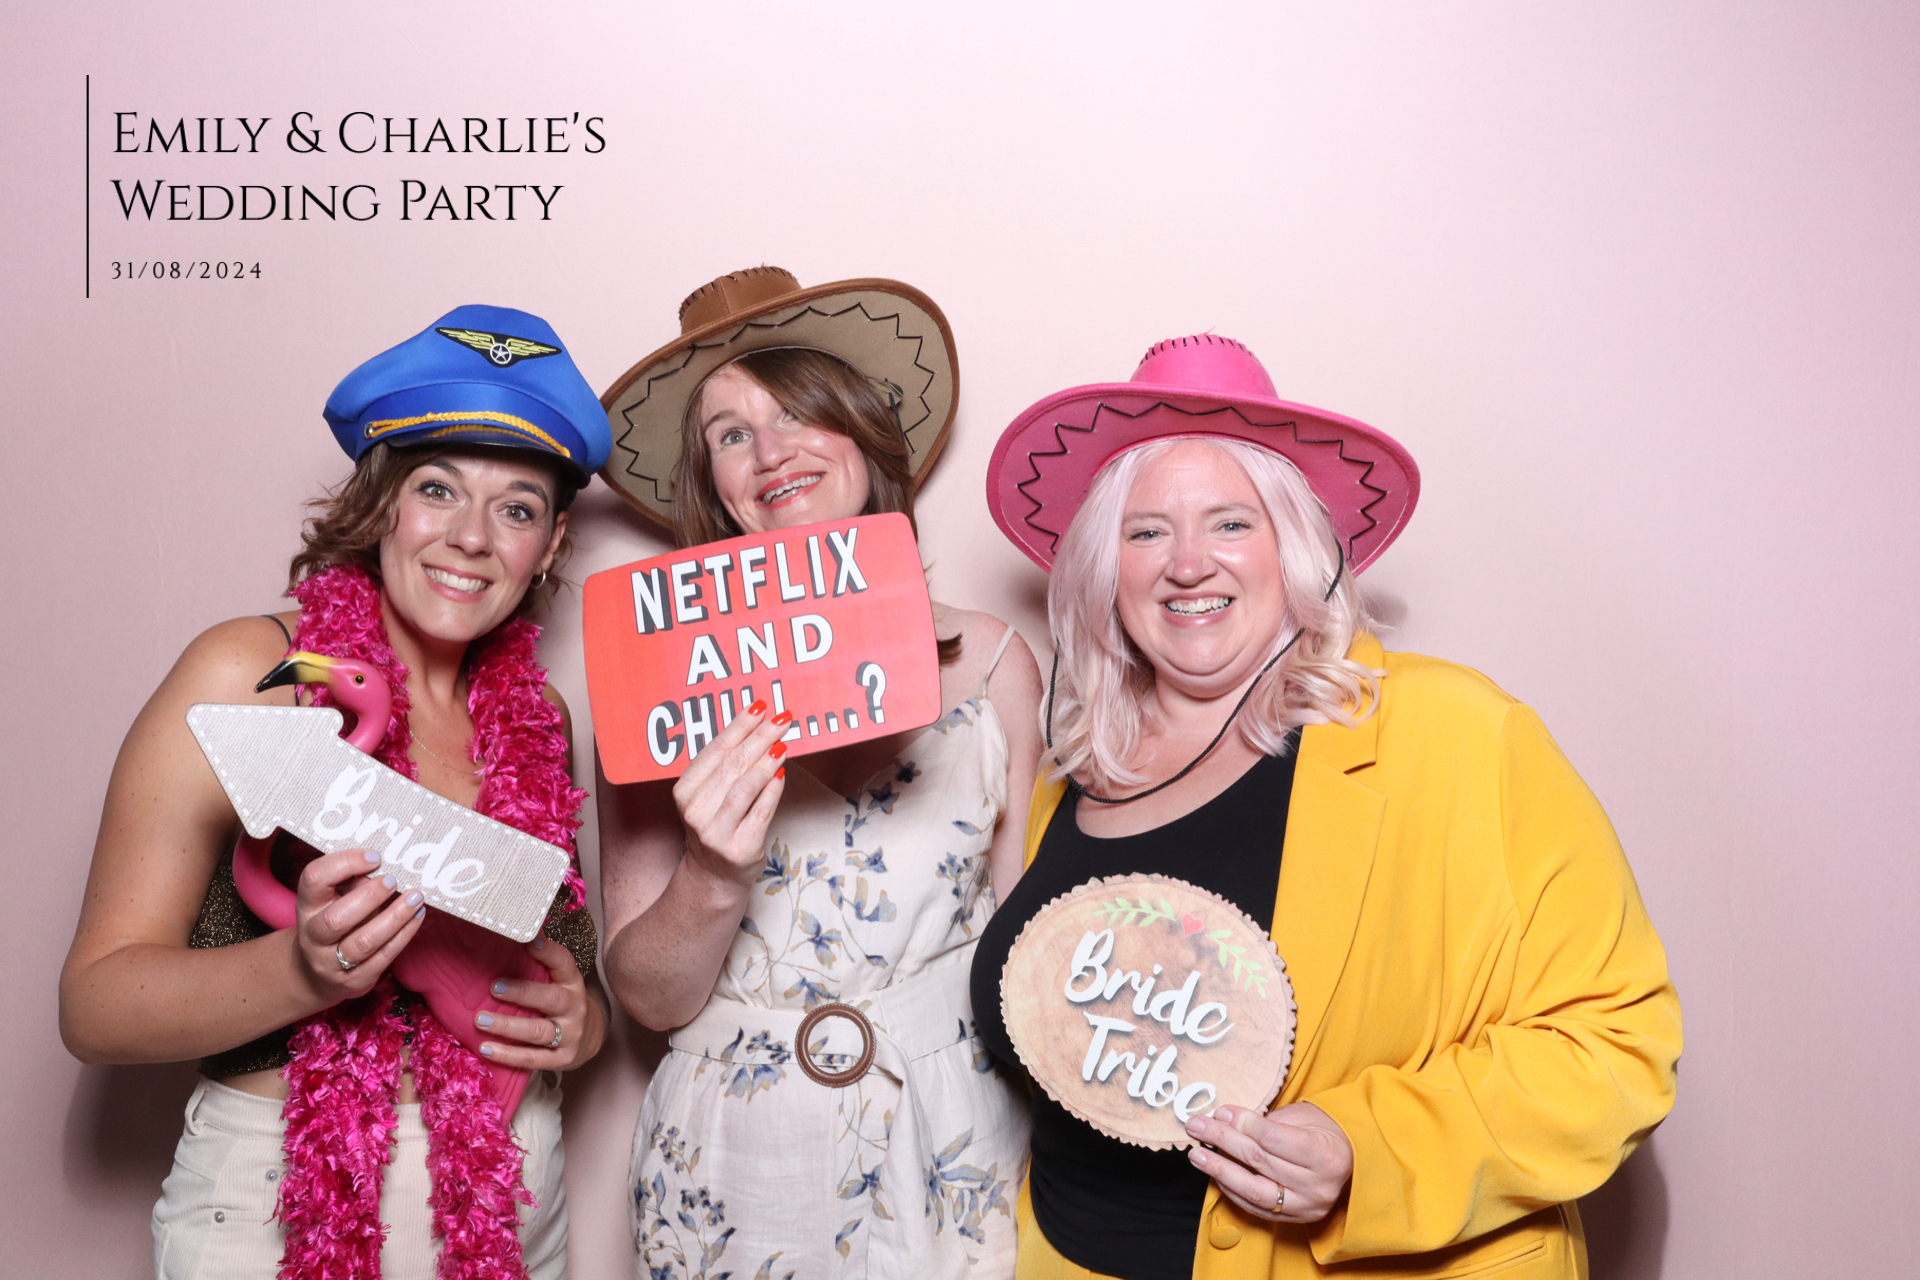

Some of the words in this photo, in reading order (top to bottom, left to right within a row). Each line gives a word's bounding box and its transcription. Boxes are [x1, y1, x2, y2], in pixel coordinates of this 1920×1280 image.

[631, 527, 869, 635] NETFLIX
[686, 613, 834, 686] AND
[312, 764, 491, 899] Bride
[1064, 928, 1235, 1044] Bride
[1081, 1010, 1224, 1124] Tribe
